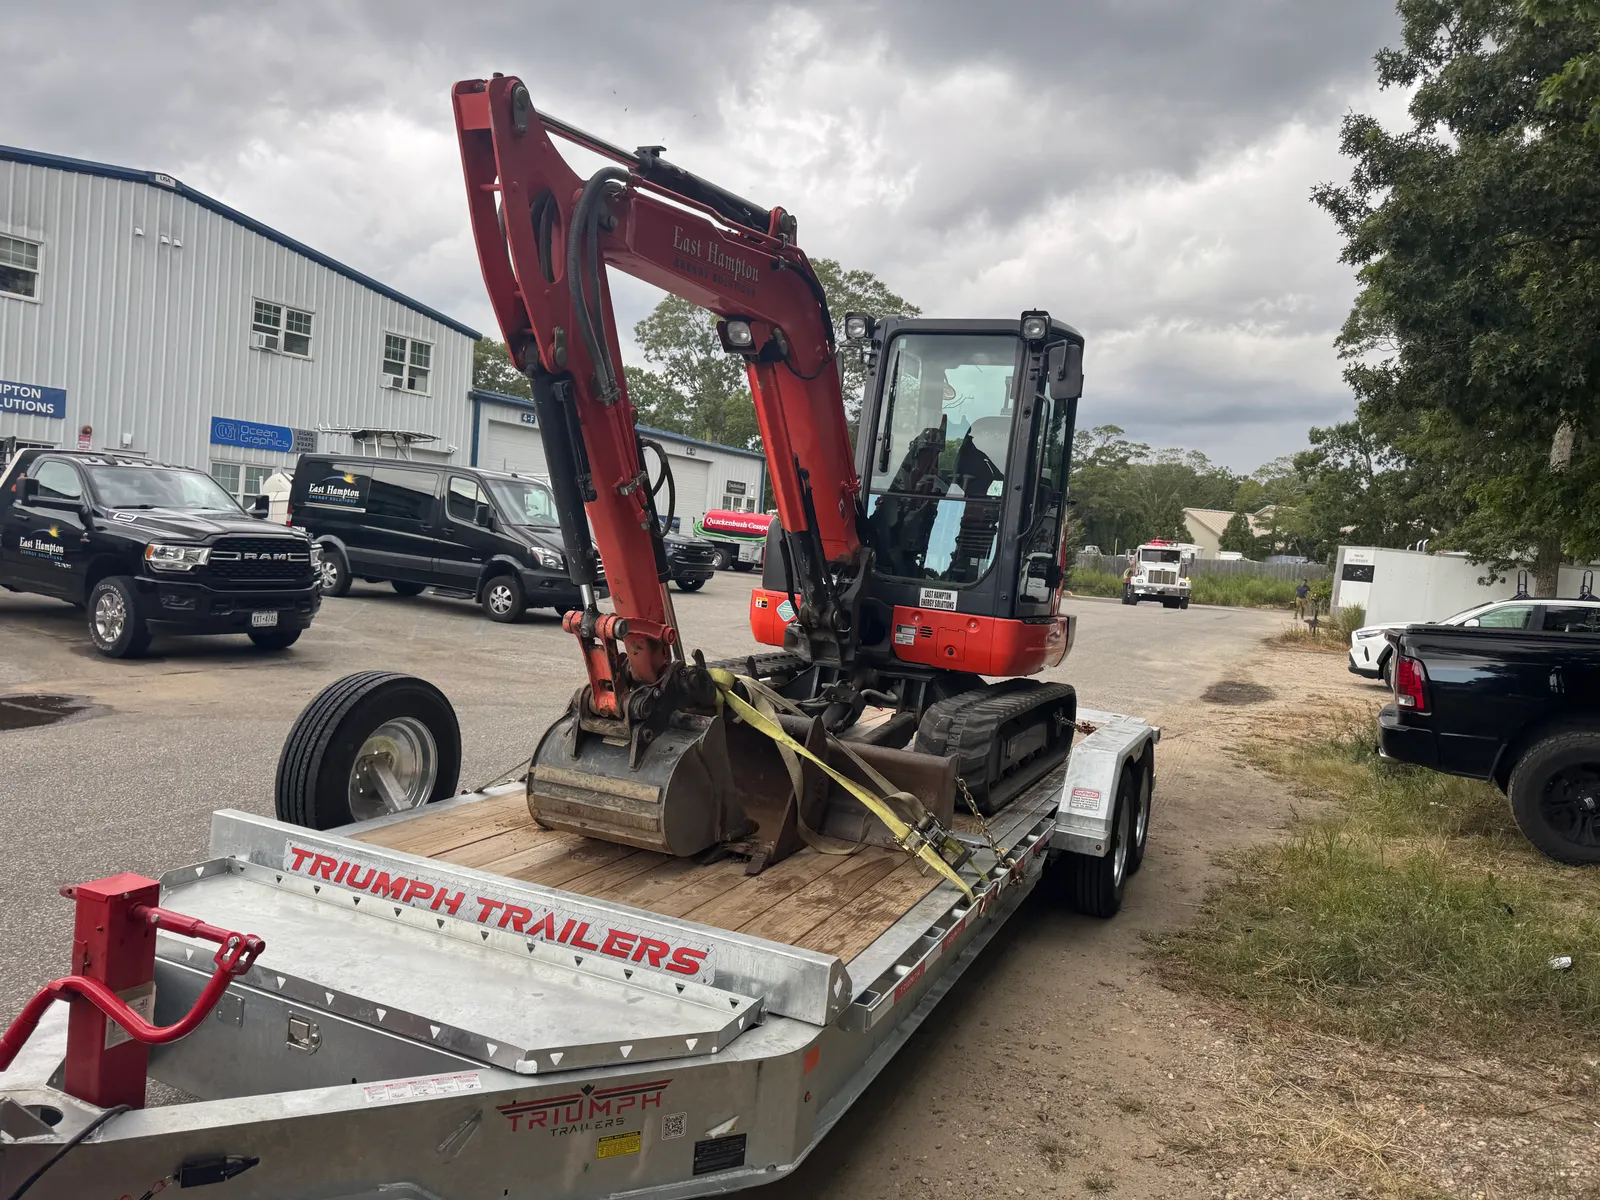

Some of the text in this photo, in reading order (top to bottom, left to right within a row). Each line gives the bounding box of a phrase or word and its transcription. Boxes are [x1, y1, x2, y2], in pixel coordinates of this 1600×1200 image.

[672, 225, 759, 281] East Hampton
[241, 425, 278, 438] Ocean
[240, 434, 289, 448] Graphics
[308, 483, 360, 498] East Hampton
[706, 517, 748, 528] Quackenbush
[20, 536, 64, 554] East Hampton
[924, 590, 952, 600] EAST HAMPTON
[921, 598, 954, 609] ENERGY SOLUTIONS
[292, 848, 708, 976] TRIUMPH TRAILERS
[506, 1092, 662, 1132] TRIUMPH
[550, 1117, 625, 1138] TRAILERS
